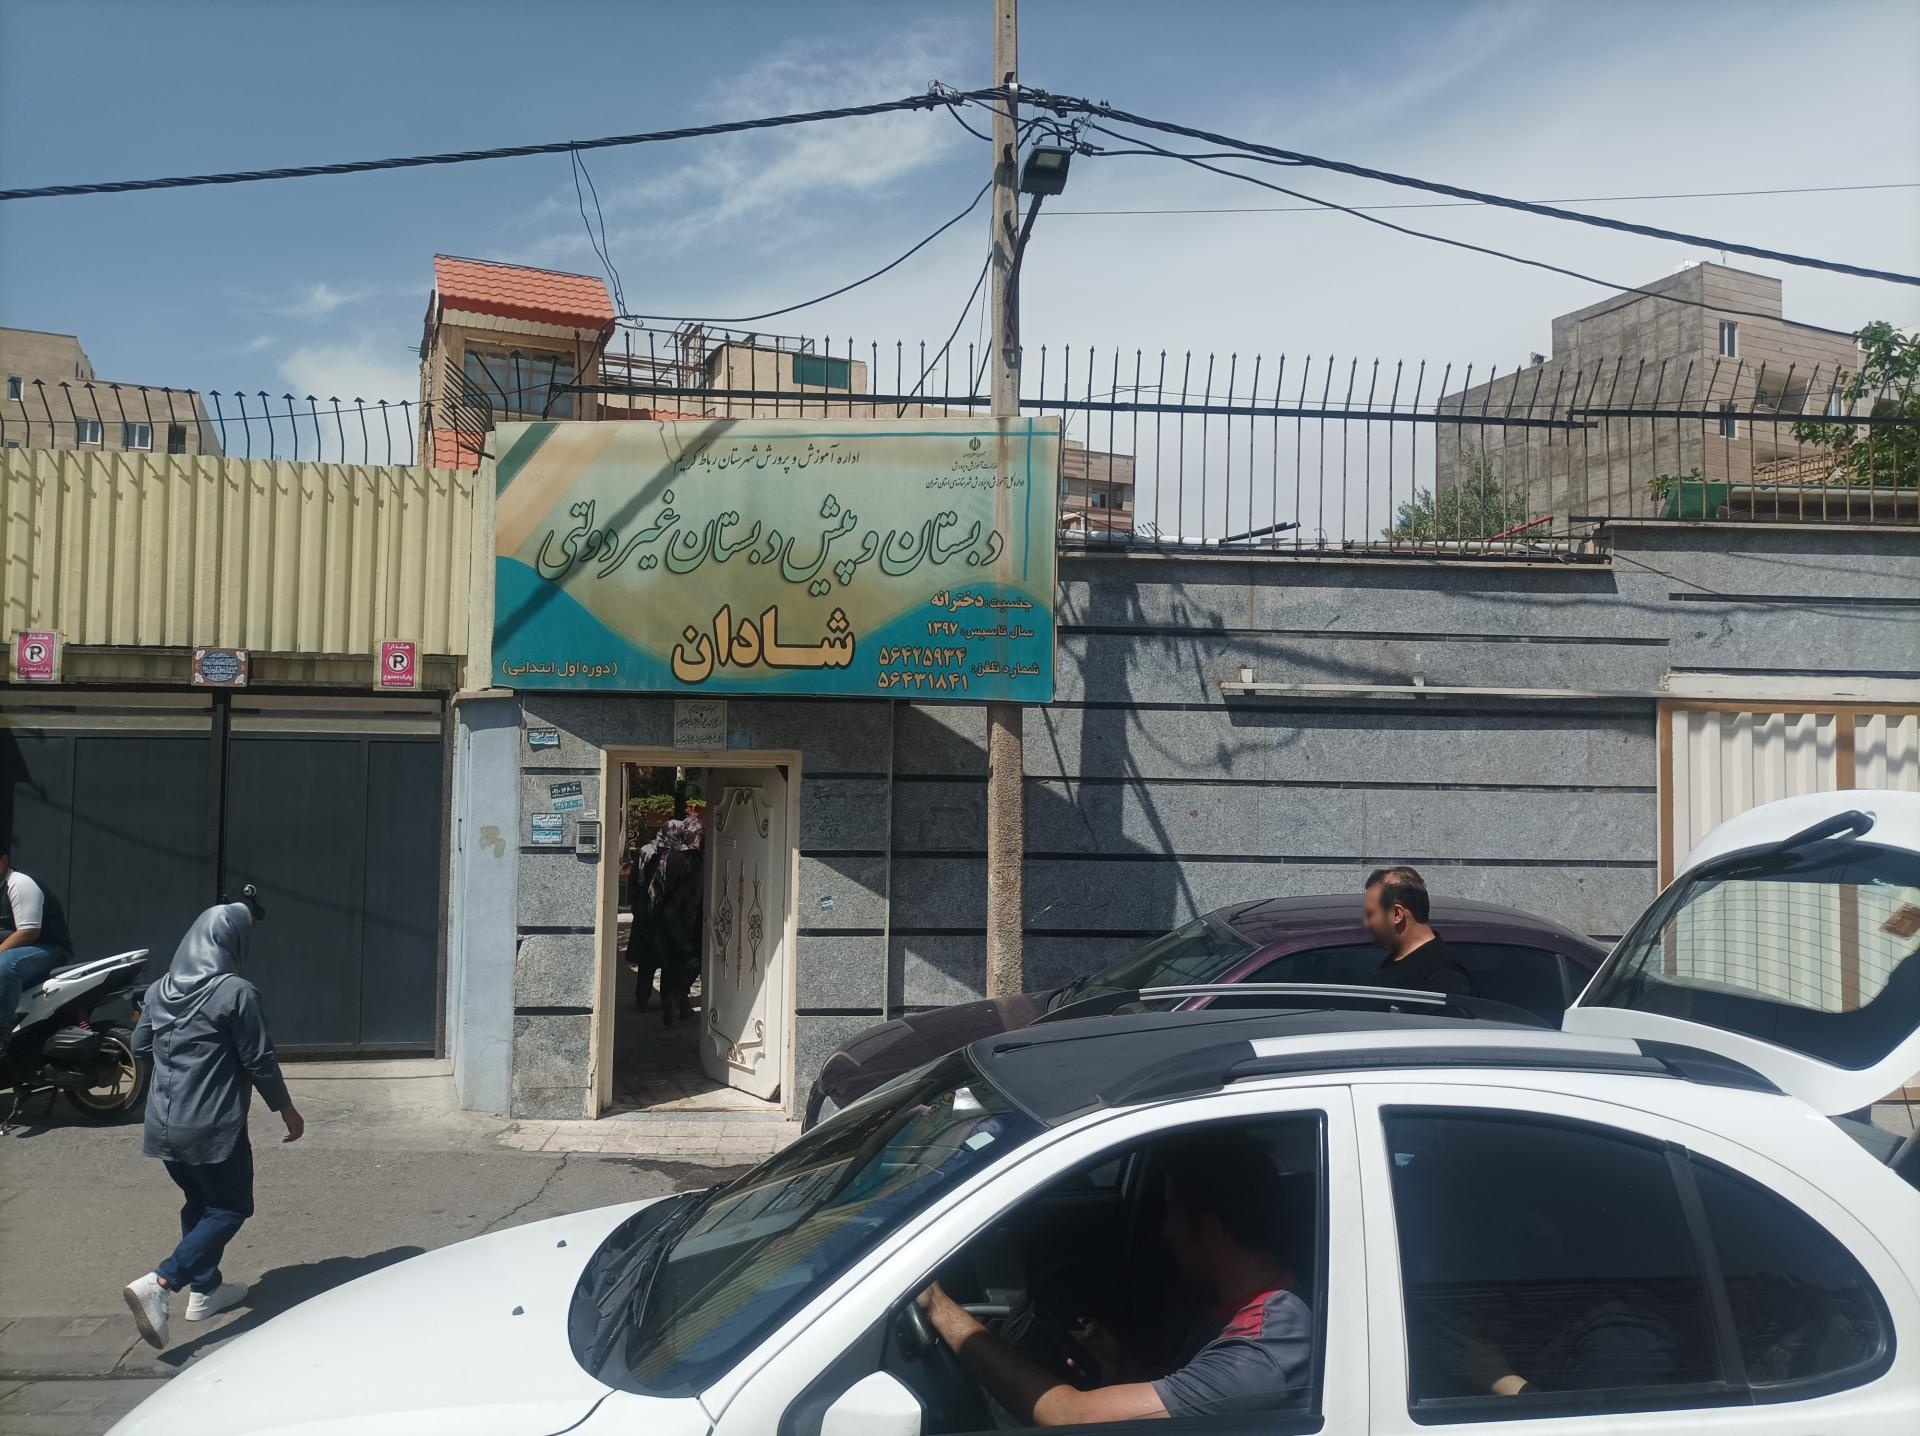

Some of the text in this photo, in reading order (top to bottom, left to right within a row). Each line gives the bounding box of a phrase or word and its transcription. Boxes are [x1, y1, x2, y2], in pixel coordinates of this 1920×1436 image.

[674, 442, 859, 473] اداره آموزش و پرورش شهرستان رباط کریم
[967, 461, 984, 471] آموزش
[989, 476, 1008, 489] آموزش
[666, 510, 783, 575] دبستان
[781, 493, 857, 597] پیش
[855, 530, 880, 564] و
[880, 510, 1004, 576] دبستان
[930, 590, 984, 613] دخترانه
[927, 620, 959, 637] ۱۳۹۷
[1008, 626, 1034, 639] سال
[671, 603, 856, 686] شادان
[878, 644, 968, 668] ۵۶۴۲۵۹۳۴
[556, 660, 580, 678] اول
[971, 660, 1039, 680] شماره تلفن:
[877, 670, 969, 692] ۵۶۴۳۱۸۴۱
